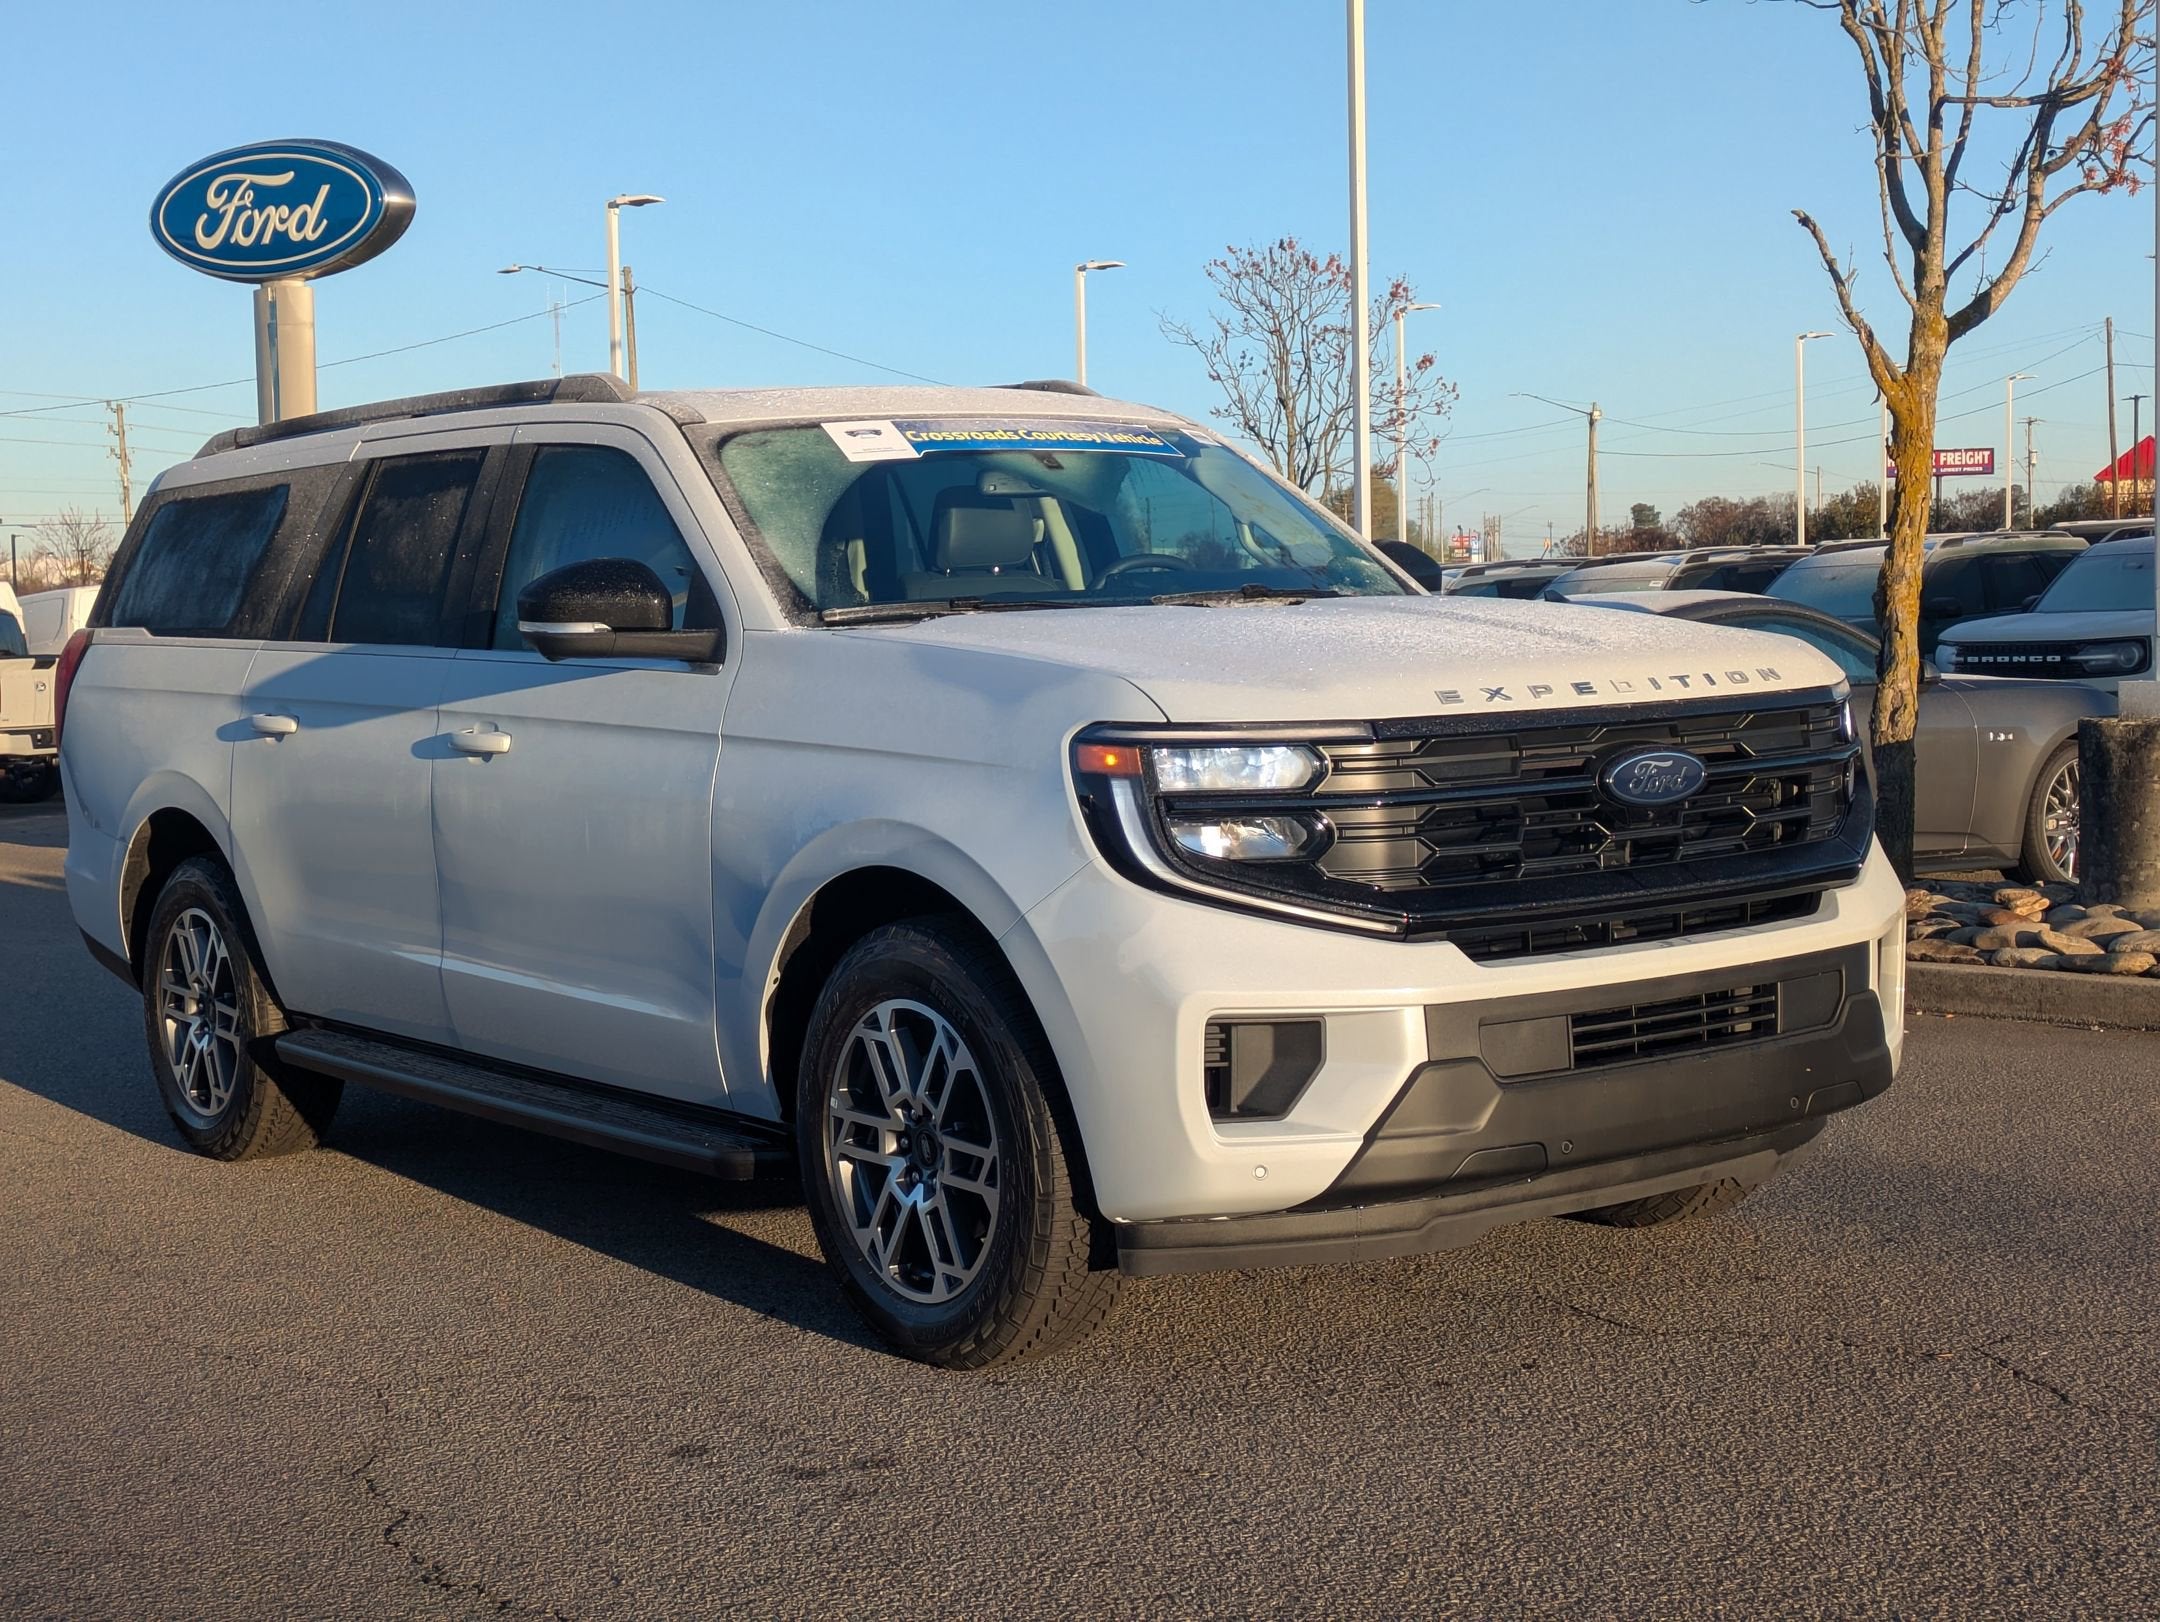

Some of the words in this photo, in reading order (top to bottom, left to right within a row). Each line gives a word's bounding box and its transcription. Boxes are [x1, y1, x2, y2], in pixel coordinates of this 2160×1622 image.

[194, 170, 331, 250] Ford
[905, 428, 1020, 442] Crossroads
[1018, 429, 1102, 443] Courtesy
[1099, 432, 1164, 446] Vehicle
[1940, 449, 1990, 466] FREIGHT
[1967, 655, 2061, 663] BRONCO
[1434, 667, 1782, 705] EXPEDITION
[1629, 760, 1687, 795] Ford
